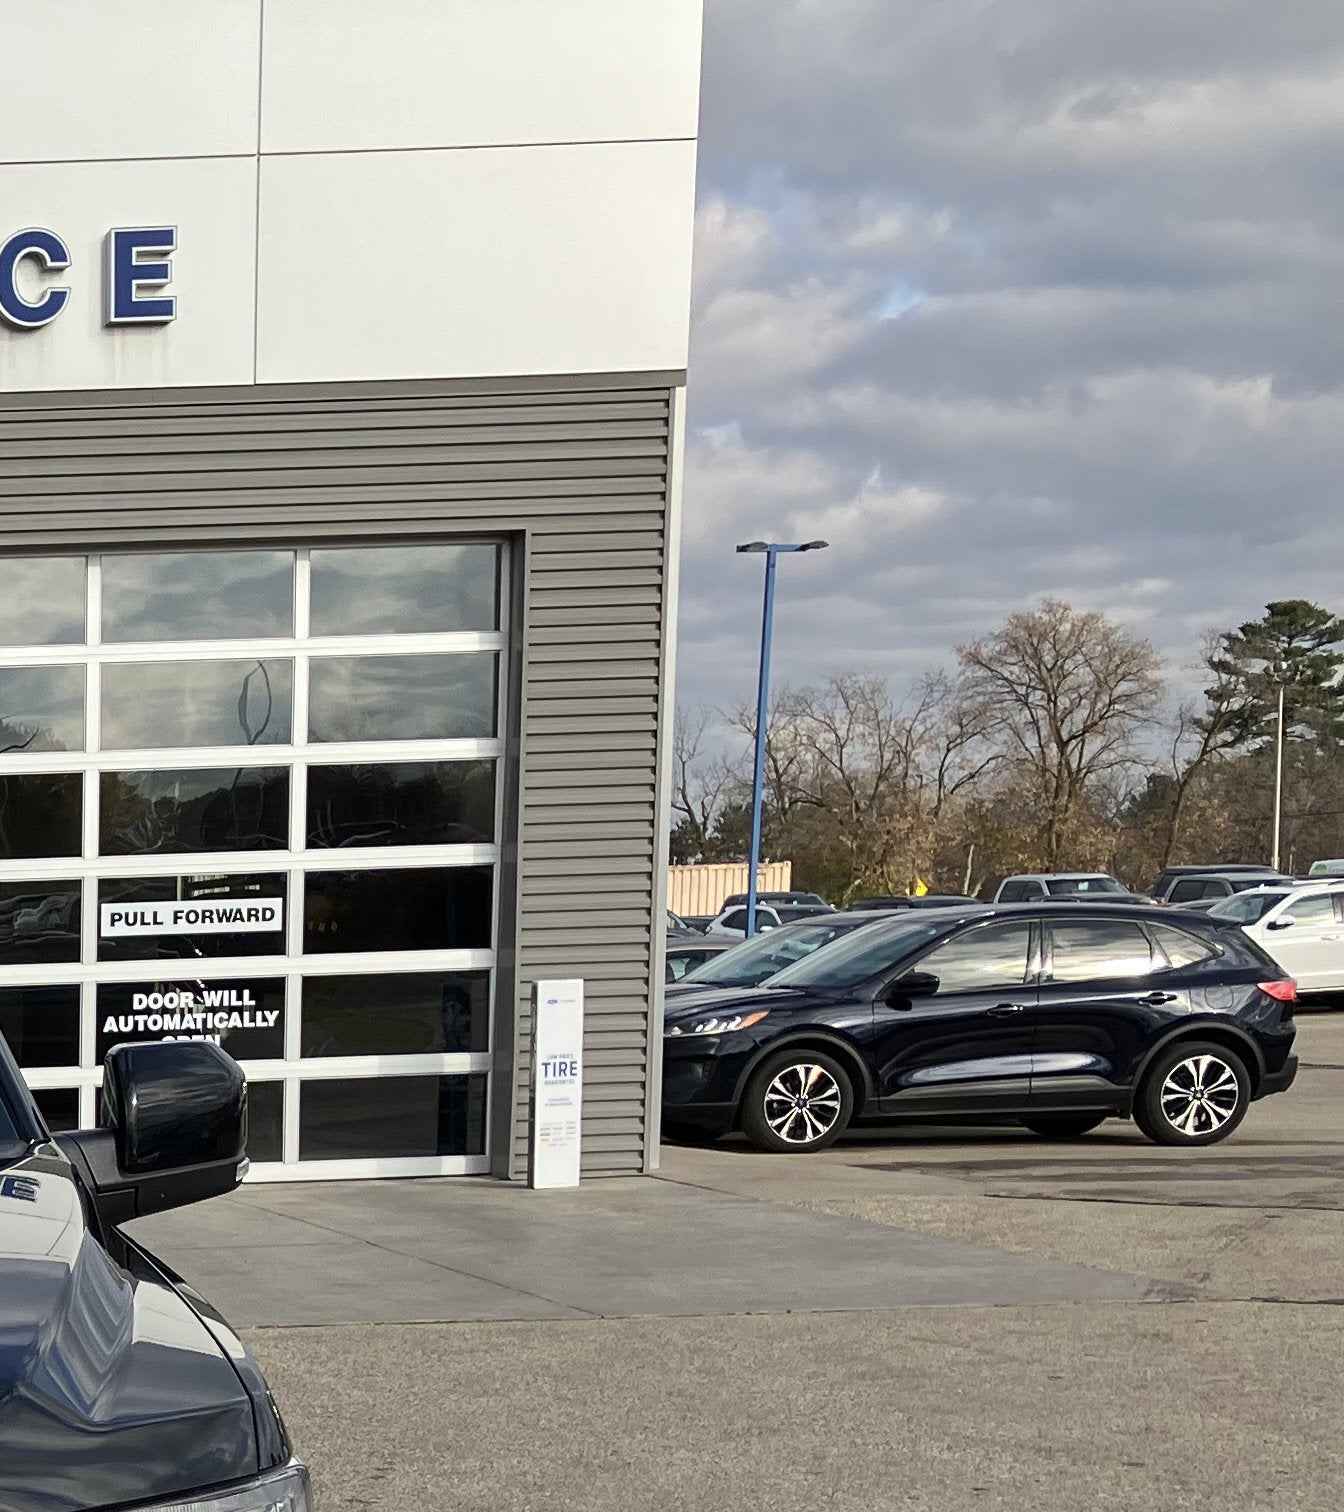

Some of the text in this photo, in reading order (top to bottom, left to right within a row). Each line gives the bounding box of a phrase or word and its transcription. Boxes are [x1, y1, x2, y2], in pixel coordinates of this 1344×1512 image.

[109, 906, 276, 927] PULL FORWARD
[132, 989, 256, 1010] DOOR WILL
[102, 1010, 280, 1033] AUTOMATICALLY
[541, 1060, 578, 1078] TIRE
